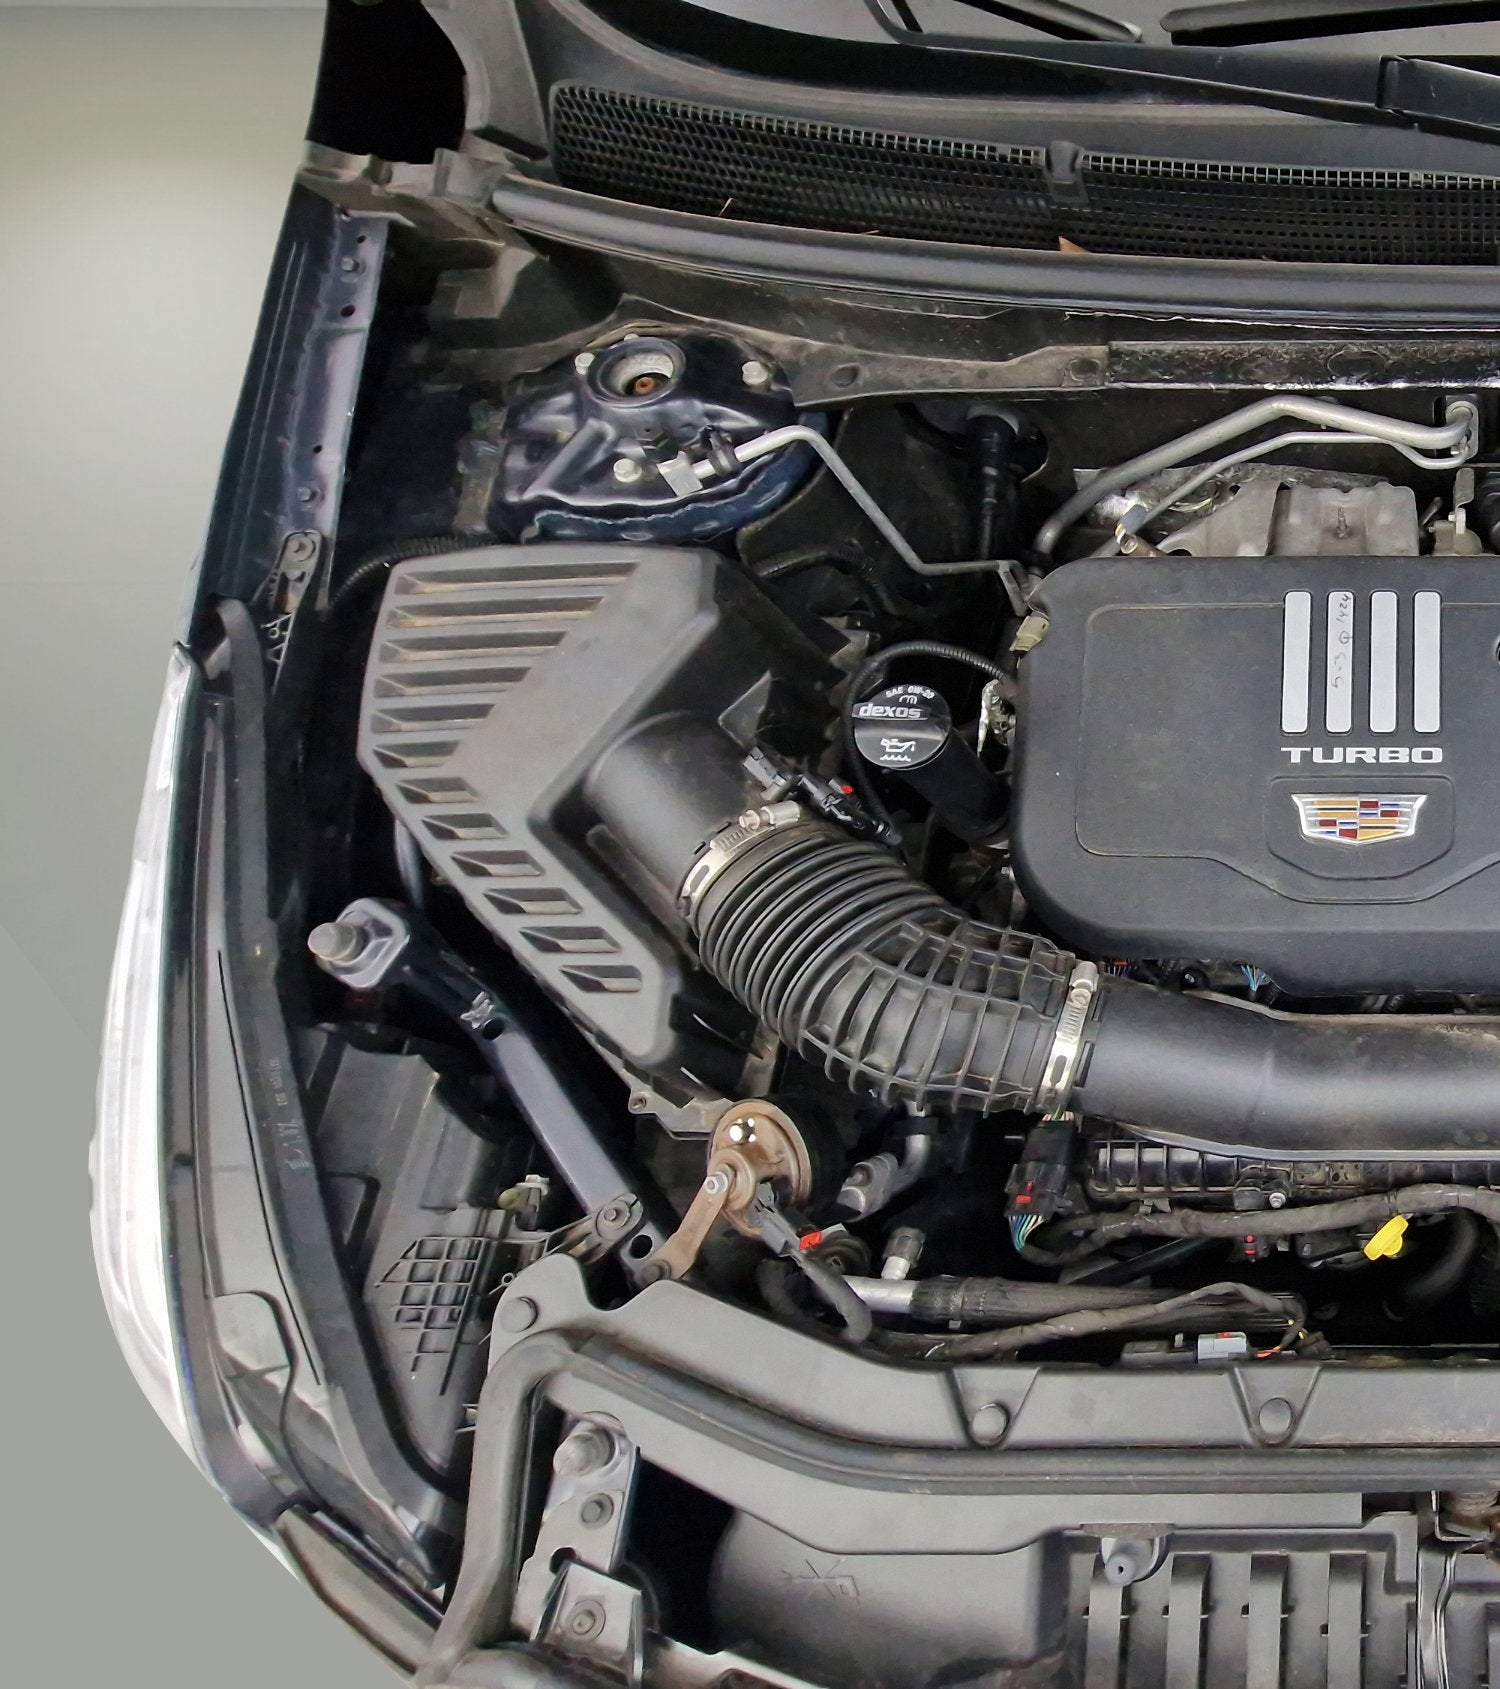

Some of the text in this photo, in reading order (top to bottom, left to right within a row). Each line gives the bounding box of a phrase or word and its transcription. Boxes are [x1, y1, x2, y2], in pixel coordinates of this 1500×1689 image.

[885, 685, 936, 700] SAE 0W-20
[858, 702, 924, 719] dexos
[1280, 747, 1444, 764] TURBO
